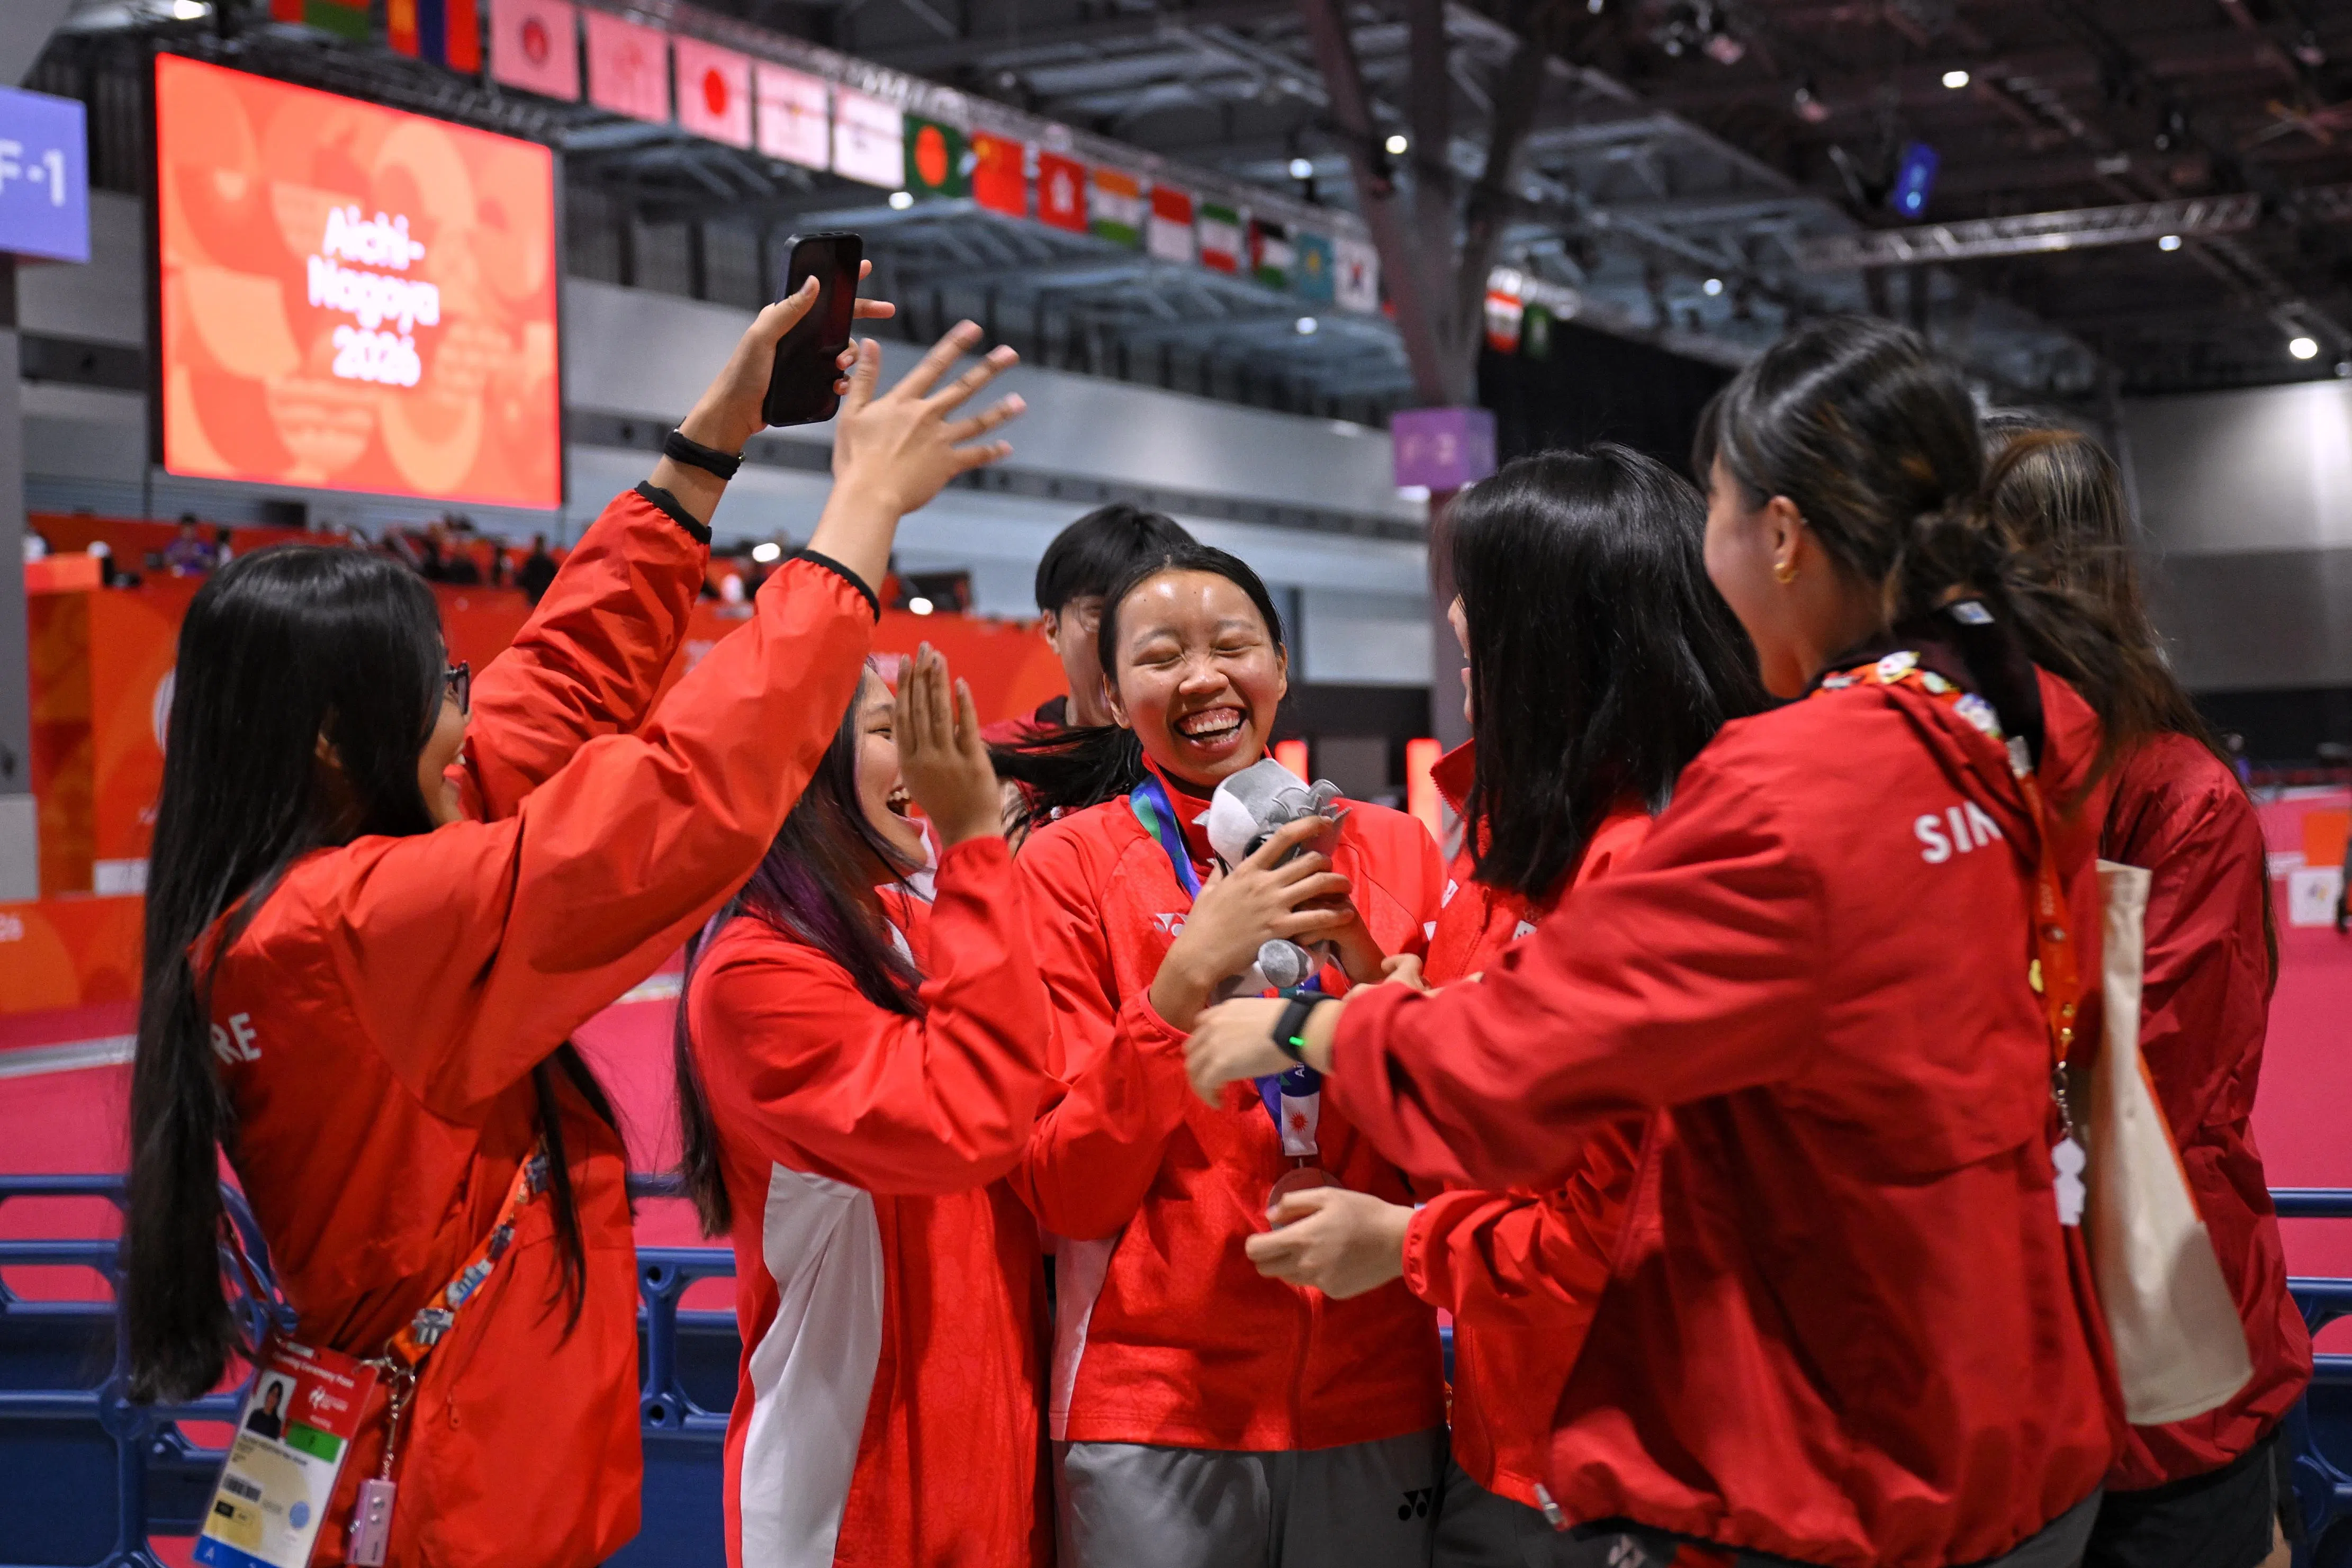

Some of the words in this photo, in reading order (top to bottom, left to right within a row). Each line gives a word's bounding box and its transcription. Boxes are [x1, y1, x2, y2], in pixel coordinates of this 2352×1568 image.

[323, 204, 425, 271] Aichi-
[308, 254, 440, 335] Nagoya
[332, 325, 421, 387] 2026
